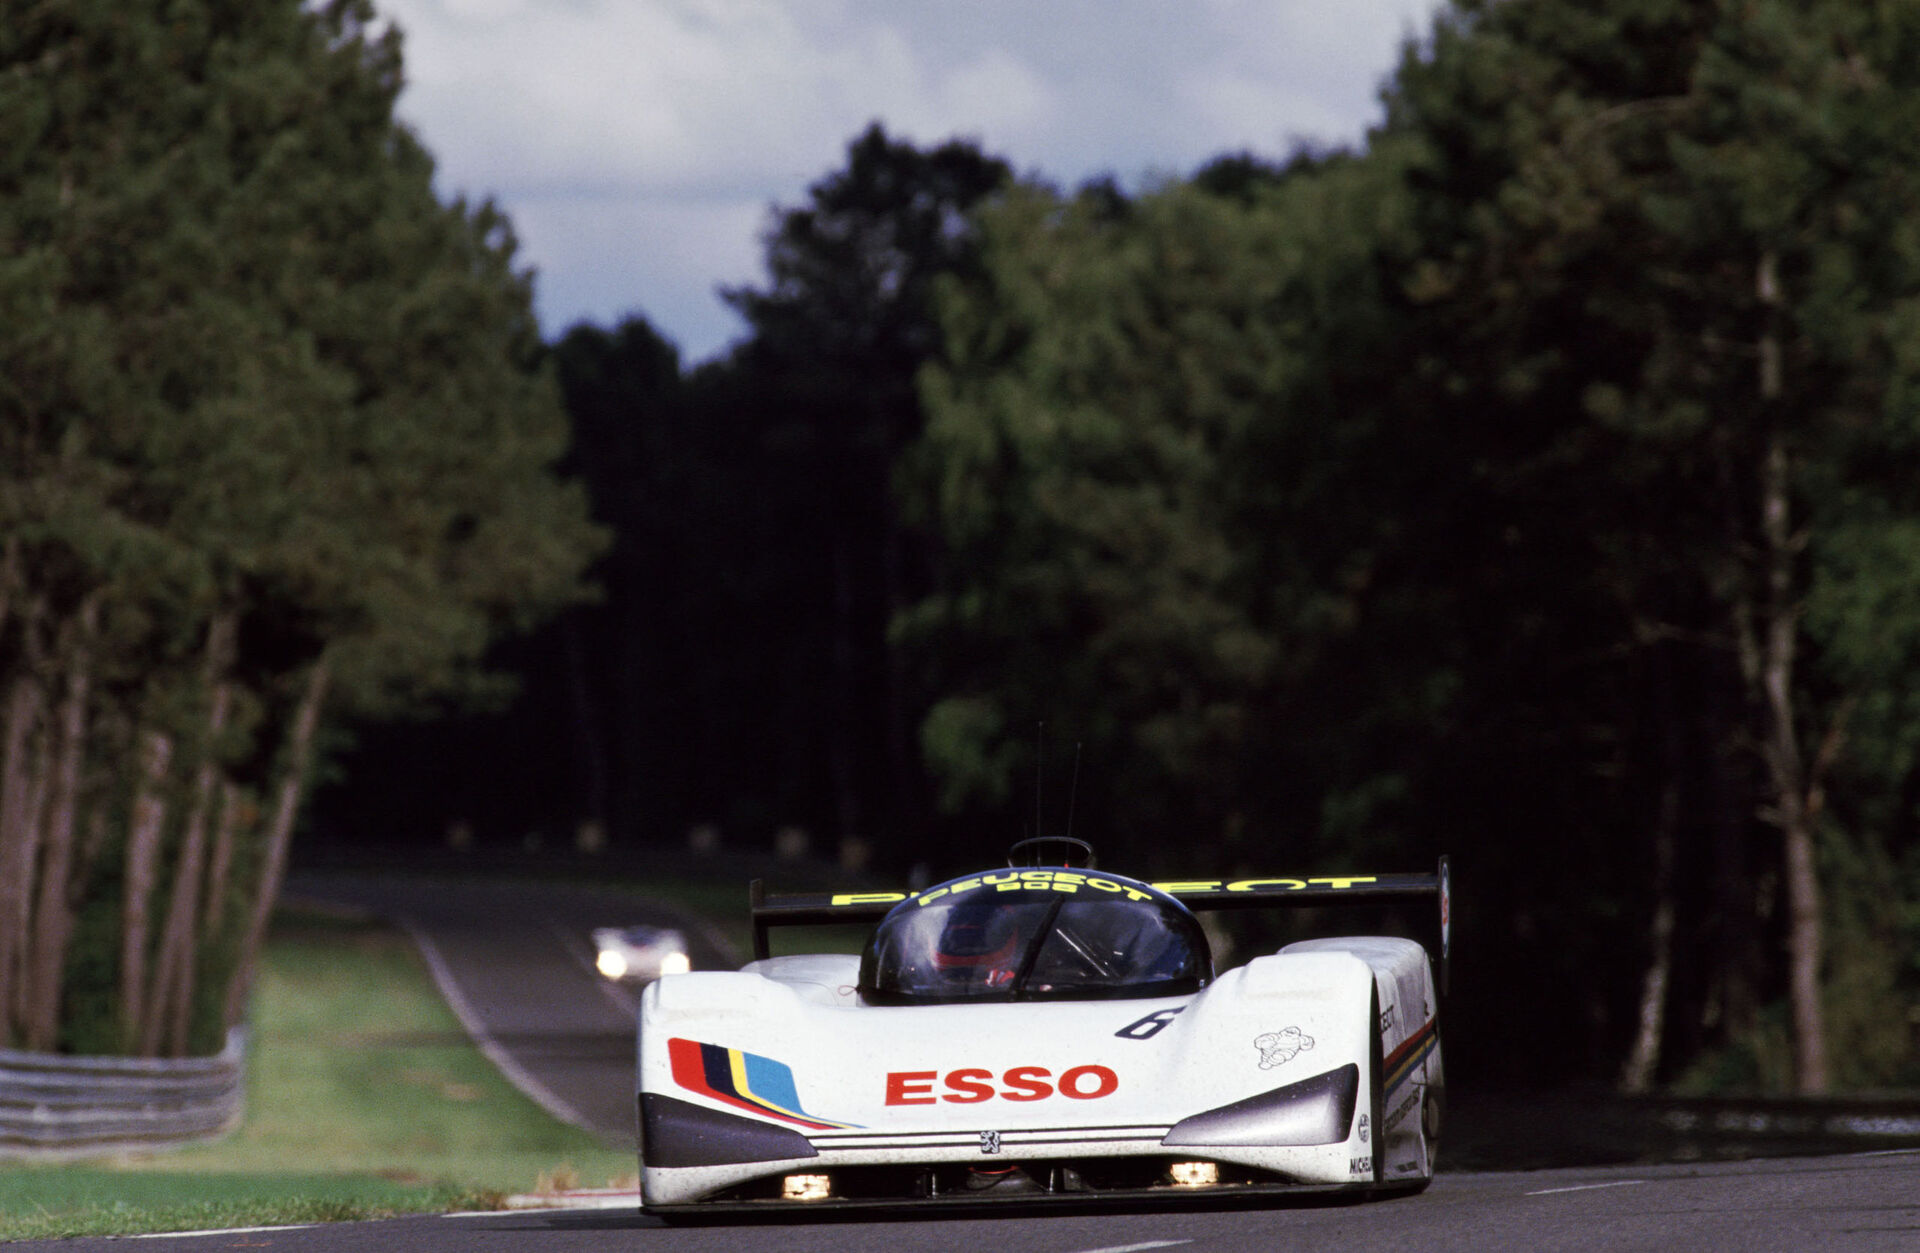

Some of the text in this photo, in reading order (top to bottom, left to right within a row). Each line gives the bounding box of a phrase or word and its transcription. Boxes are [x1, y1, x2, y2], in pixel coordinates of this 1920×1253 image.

[918, 871, 1153, 907] PEUGEOT
[1114, 1004, 1188, 1040] 6
[885, 1064, 1119, 1106] ESSO
